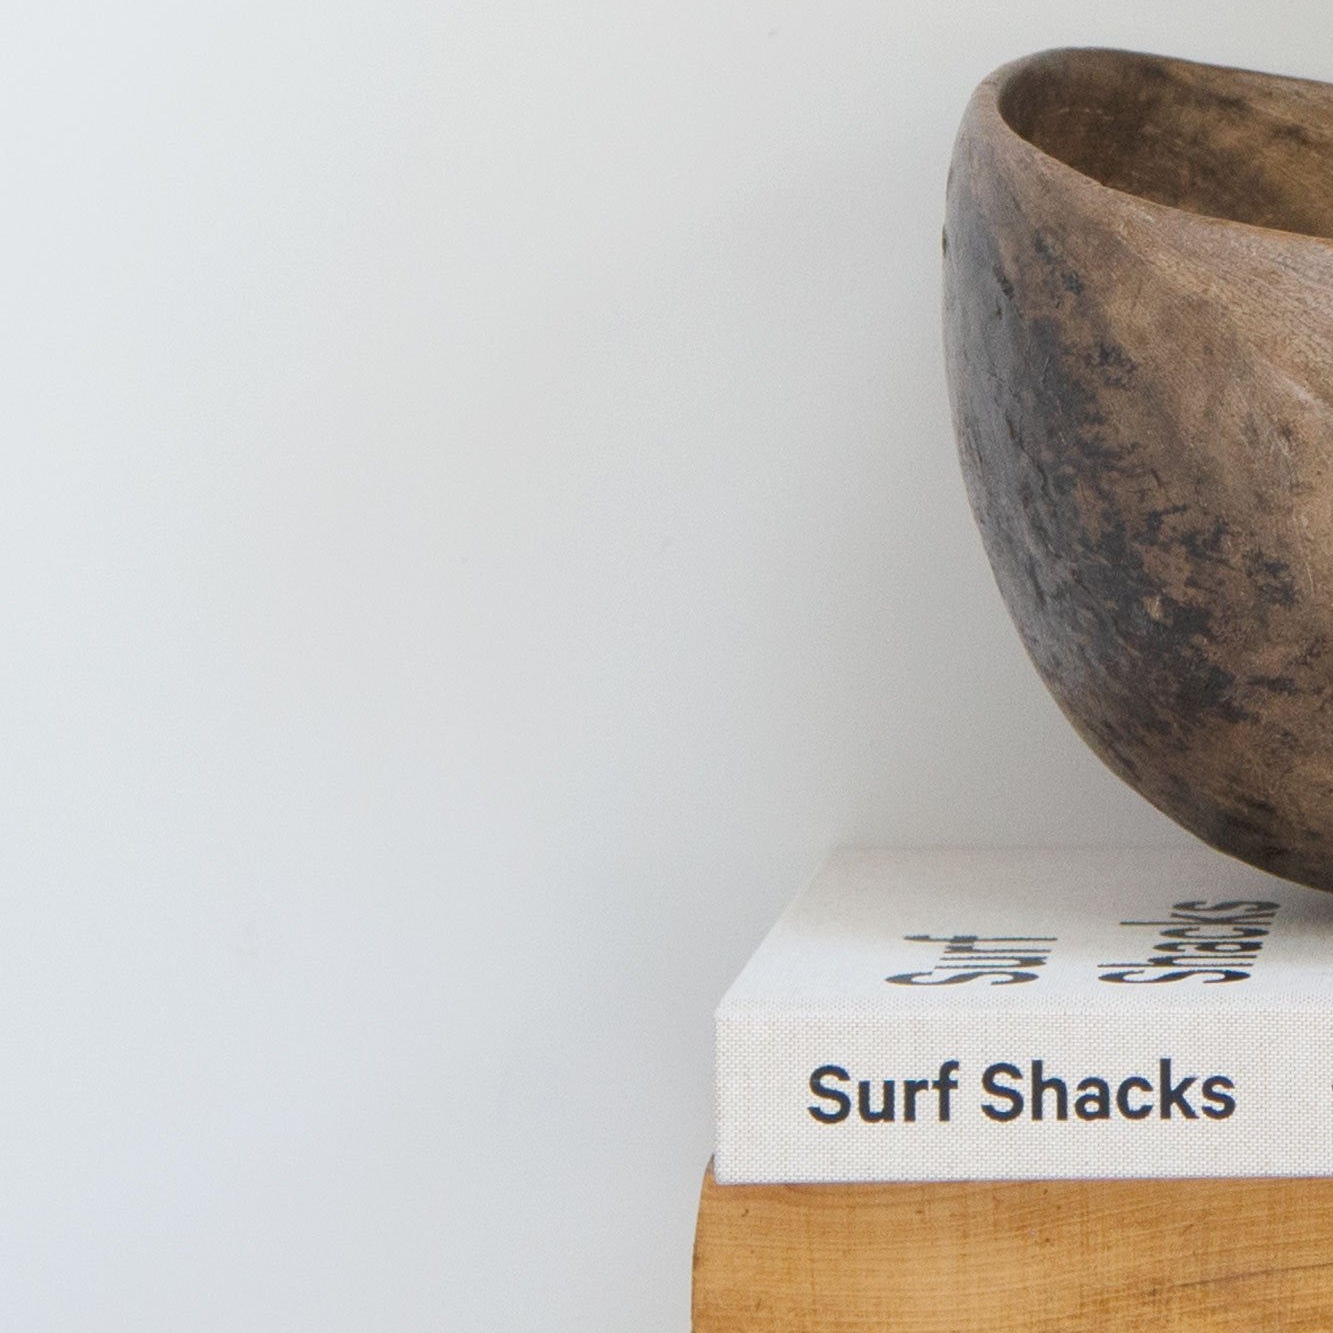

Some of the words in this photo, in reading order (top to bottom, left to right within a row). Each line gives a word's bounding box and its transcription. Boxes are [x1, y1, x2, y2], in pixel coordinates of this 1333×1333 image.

[884, 934, 1059, 986] Surf
[1096, 899, 1281, 985] Shacks
[807, 1059, 961, 1125] Surf
[980, 1057, 1238, 1123] Shacks
